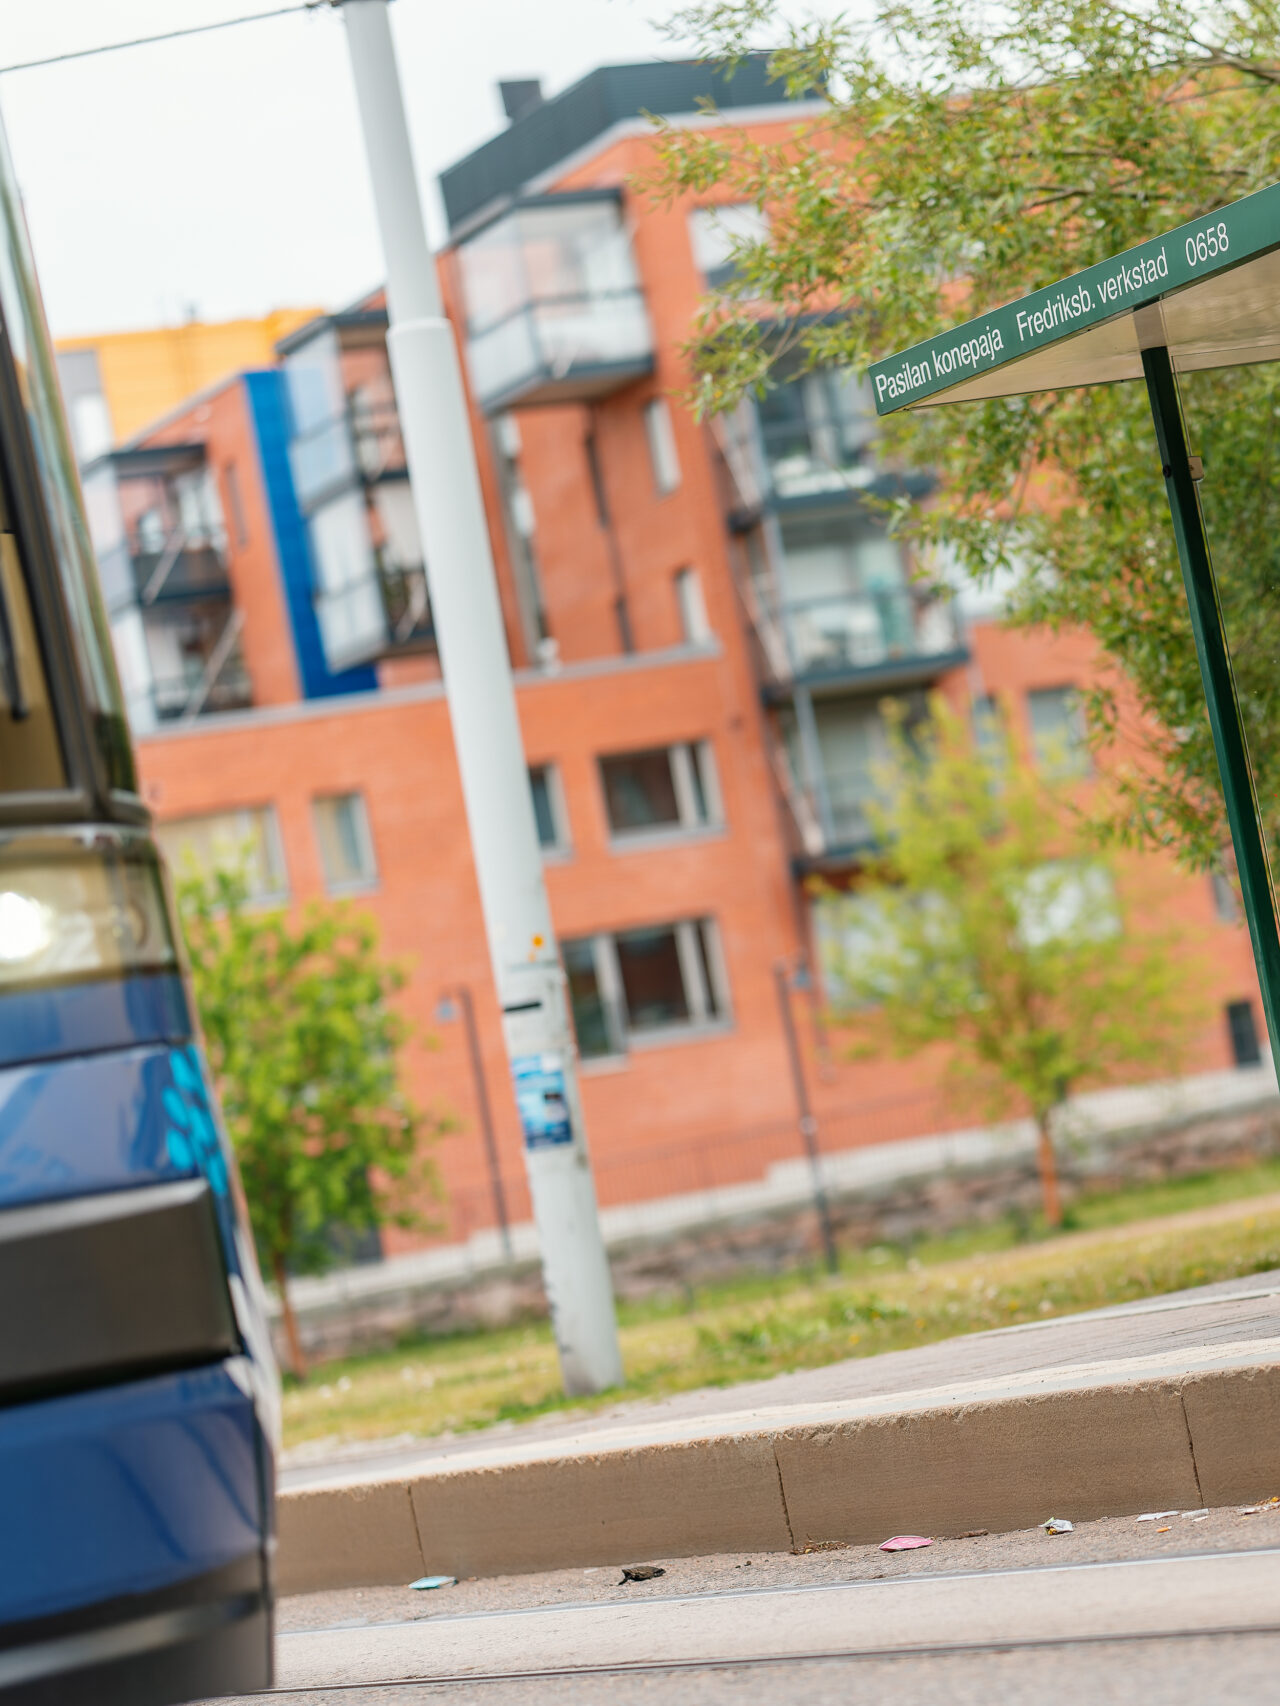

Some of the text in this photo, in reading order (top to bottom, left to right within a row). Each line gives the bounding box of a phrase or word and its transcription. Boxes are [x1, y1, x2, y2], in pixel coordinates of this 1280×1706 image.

[875, 222, 1229, 403] Pasilan konepaja Fredriksb. verkstad 0658
